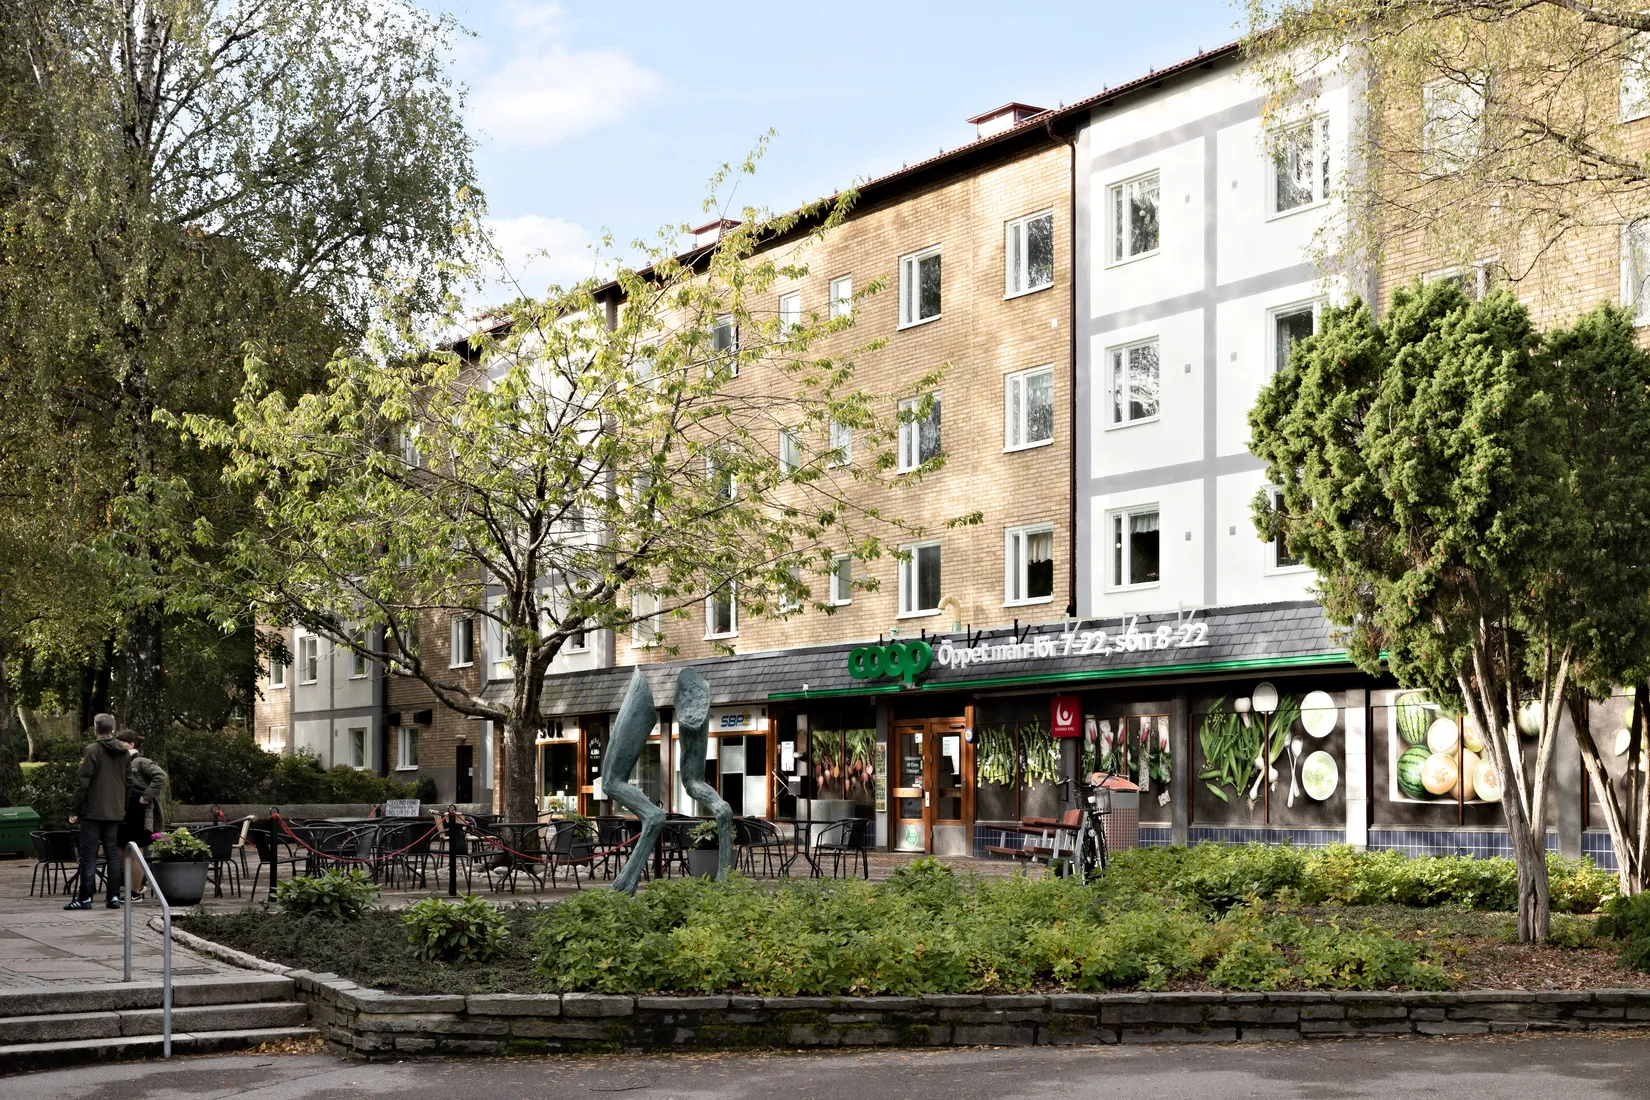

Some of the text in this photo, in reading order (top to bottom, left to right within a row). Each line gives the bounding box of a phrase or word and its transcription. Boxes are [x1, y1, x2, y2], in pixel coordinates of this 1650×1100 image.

[848, 641, 933, 684] coop
[938, 639, 989, 669] Öppet
[1115, 628, 1155, 652] sön
[1155, 622, 1209, 650] 8-22
[721, 714, 745, 728] SBP
